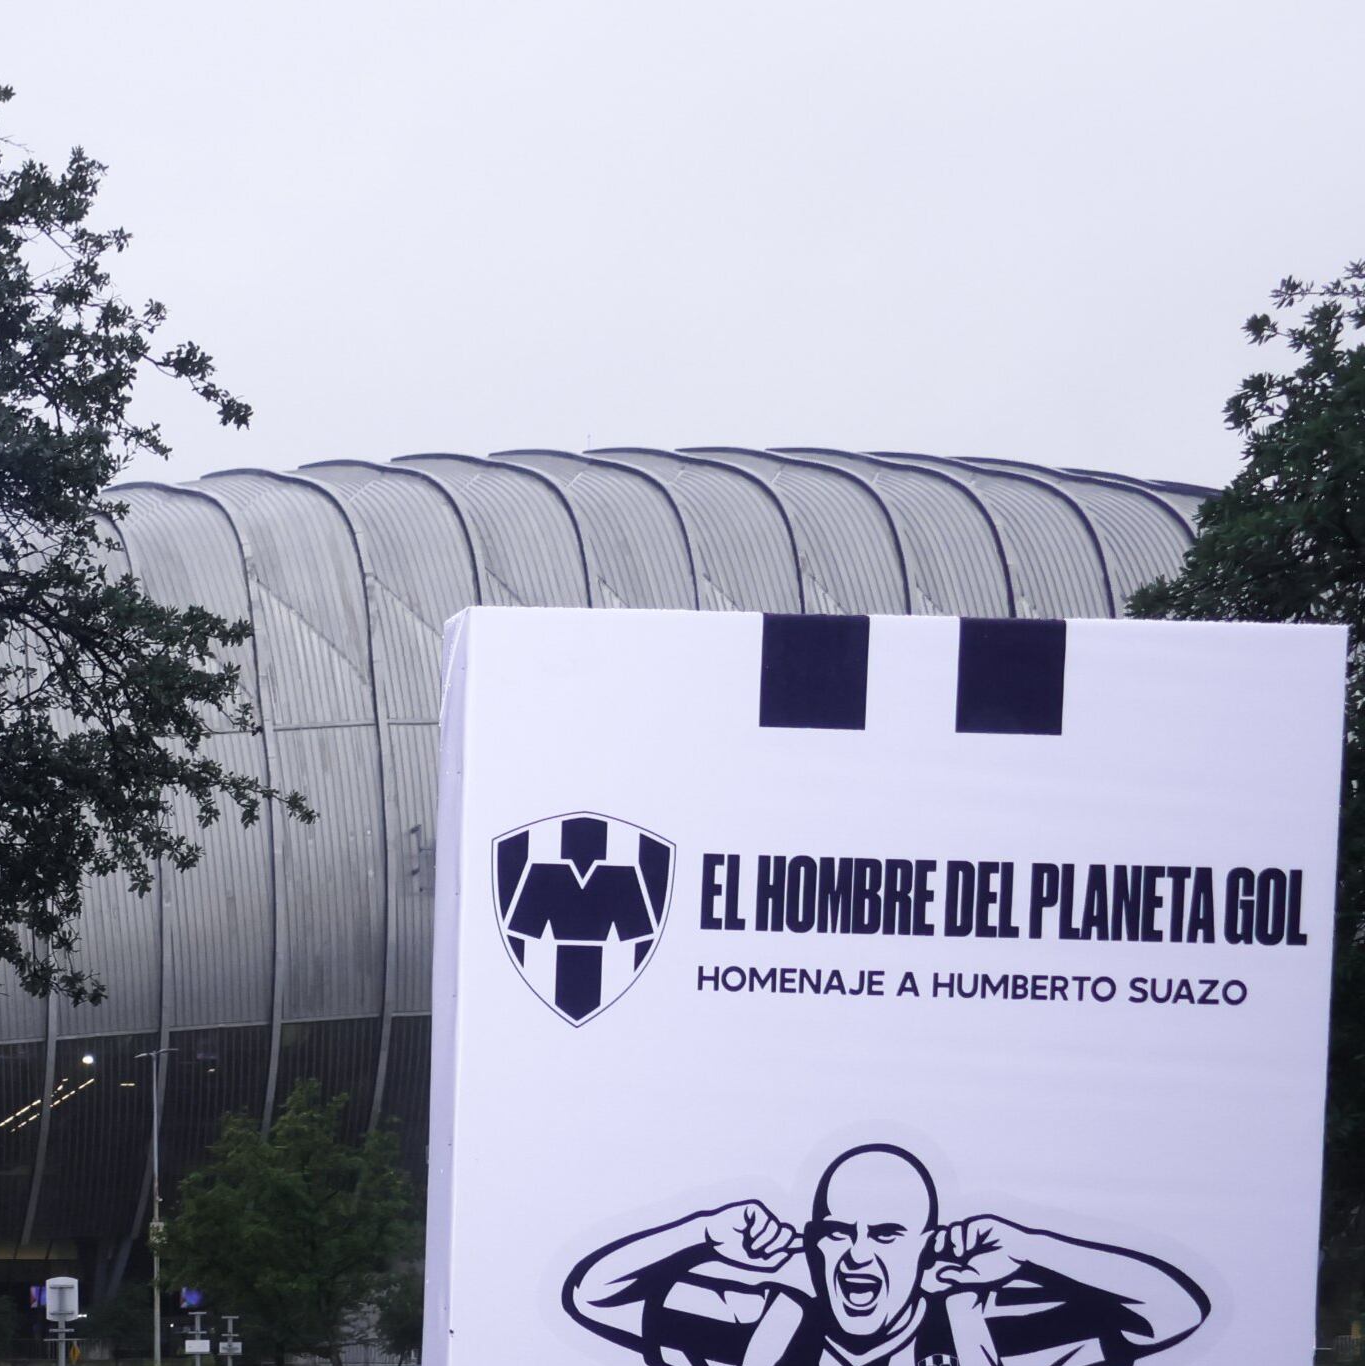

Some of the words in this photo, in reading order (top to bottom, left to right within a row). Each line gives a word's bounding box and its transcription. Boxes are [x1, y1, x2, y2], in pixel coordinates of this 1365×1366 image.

[700, 853, 746, 931] EL
[755, 855, 937, 937] HOMBRE
[944, 861, 1020, 939] DEL
[1028, 863, 1216, 944] PLANETA
[1223, 867, 1308, 947] GOL
[697, 965, 885, 996] HOMENAJE
[896, 971, 920, 998] A
[932, 972, 1117, 1003] HUMBERTO
[1128, 976, 1248, 1006] SUAZO
